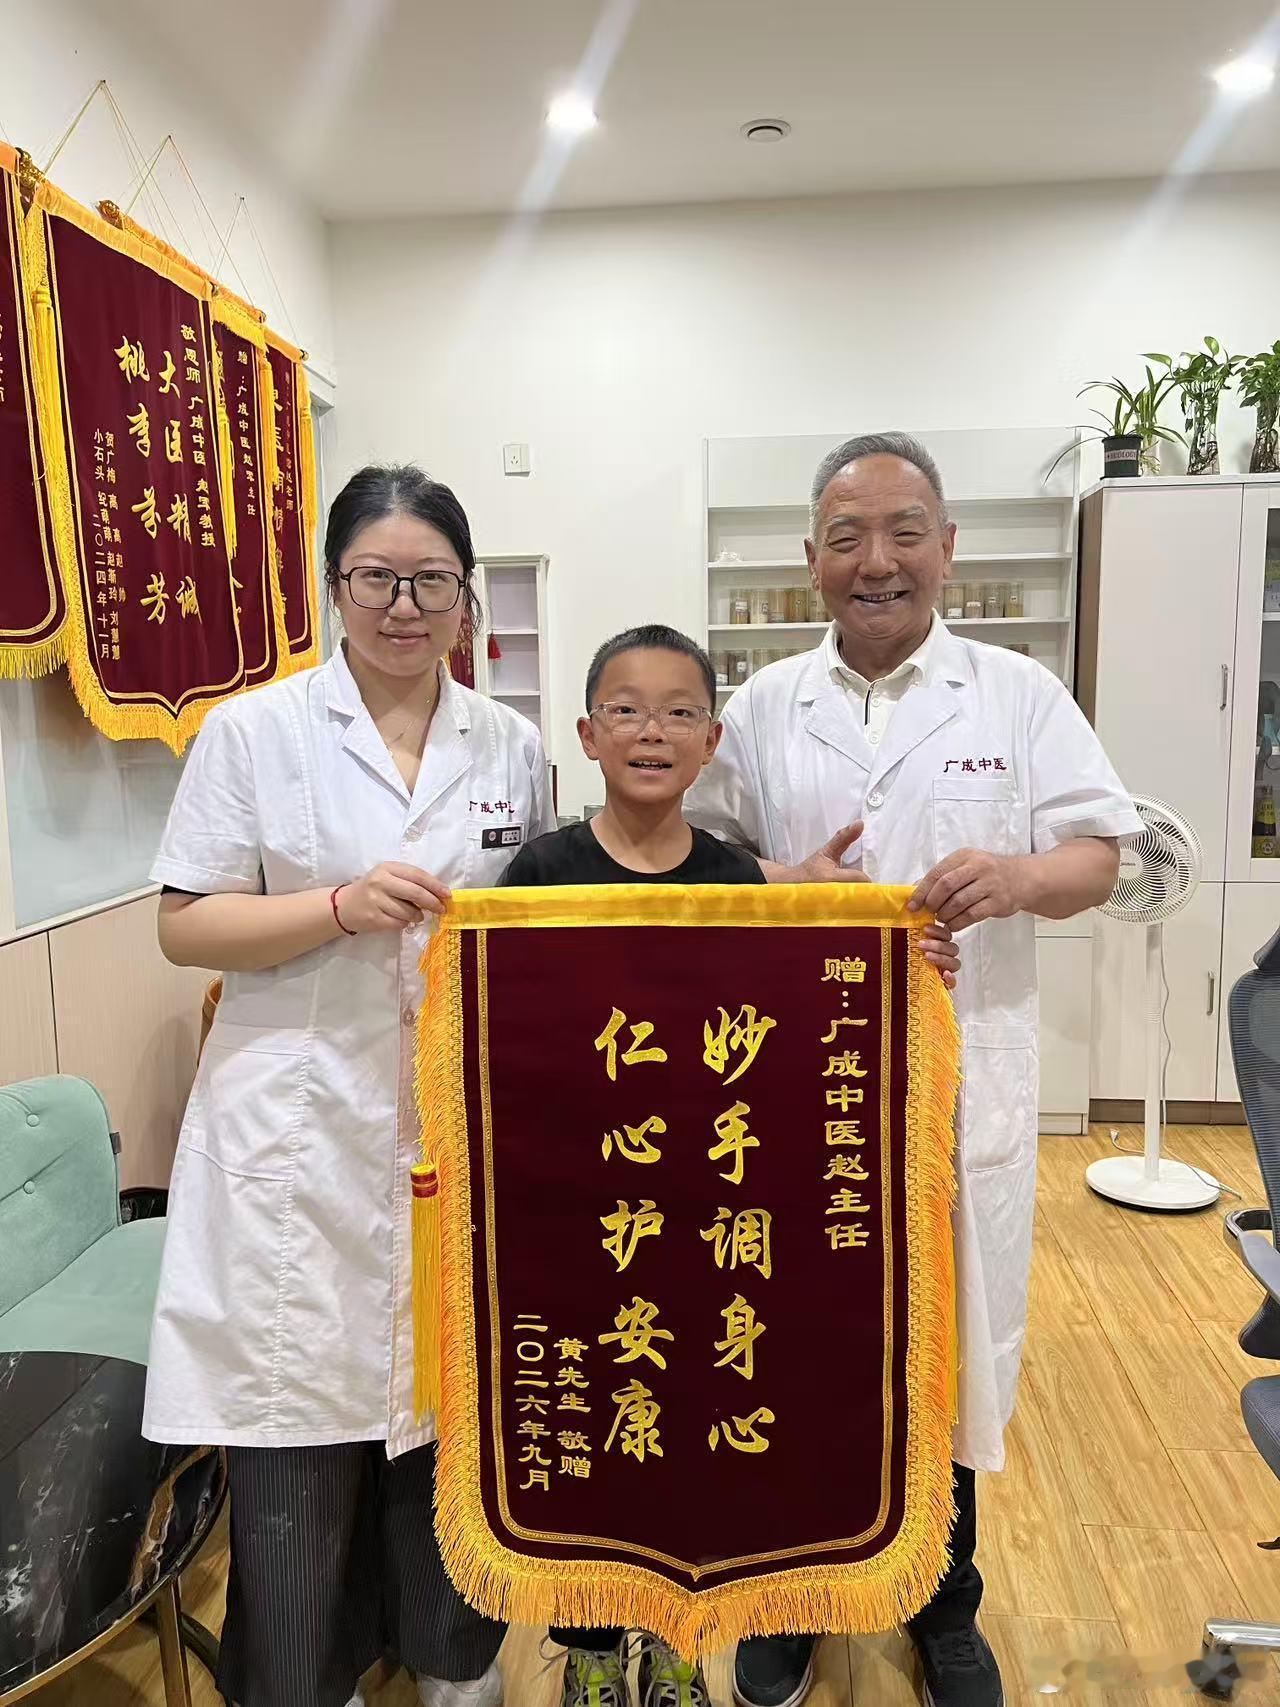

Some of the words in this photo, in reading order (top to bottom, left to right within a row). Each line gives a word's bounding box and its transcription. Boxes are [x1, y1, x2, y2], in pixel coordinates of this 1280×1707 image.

[114, 336, 169, 624] 桃李芬芳
[159, 351, 201, 622] 大医精诚
[943, 757, 1007, 773] 广成中医
[594, 1007, 675, 1463] 仁心护安康
[700, 1005, 777, 1456] 妙手调身心
[820, 957, 870, 1250] 赠：广成中医赵主任
[553, 1337, 592, 1414] 黄先生
[557, 1430, 593, 1479] 敬赠
